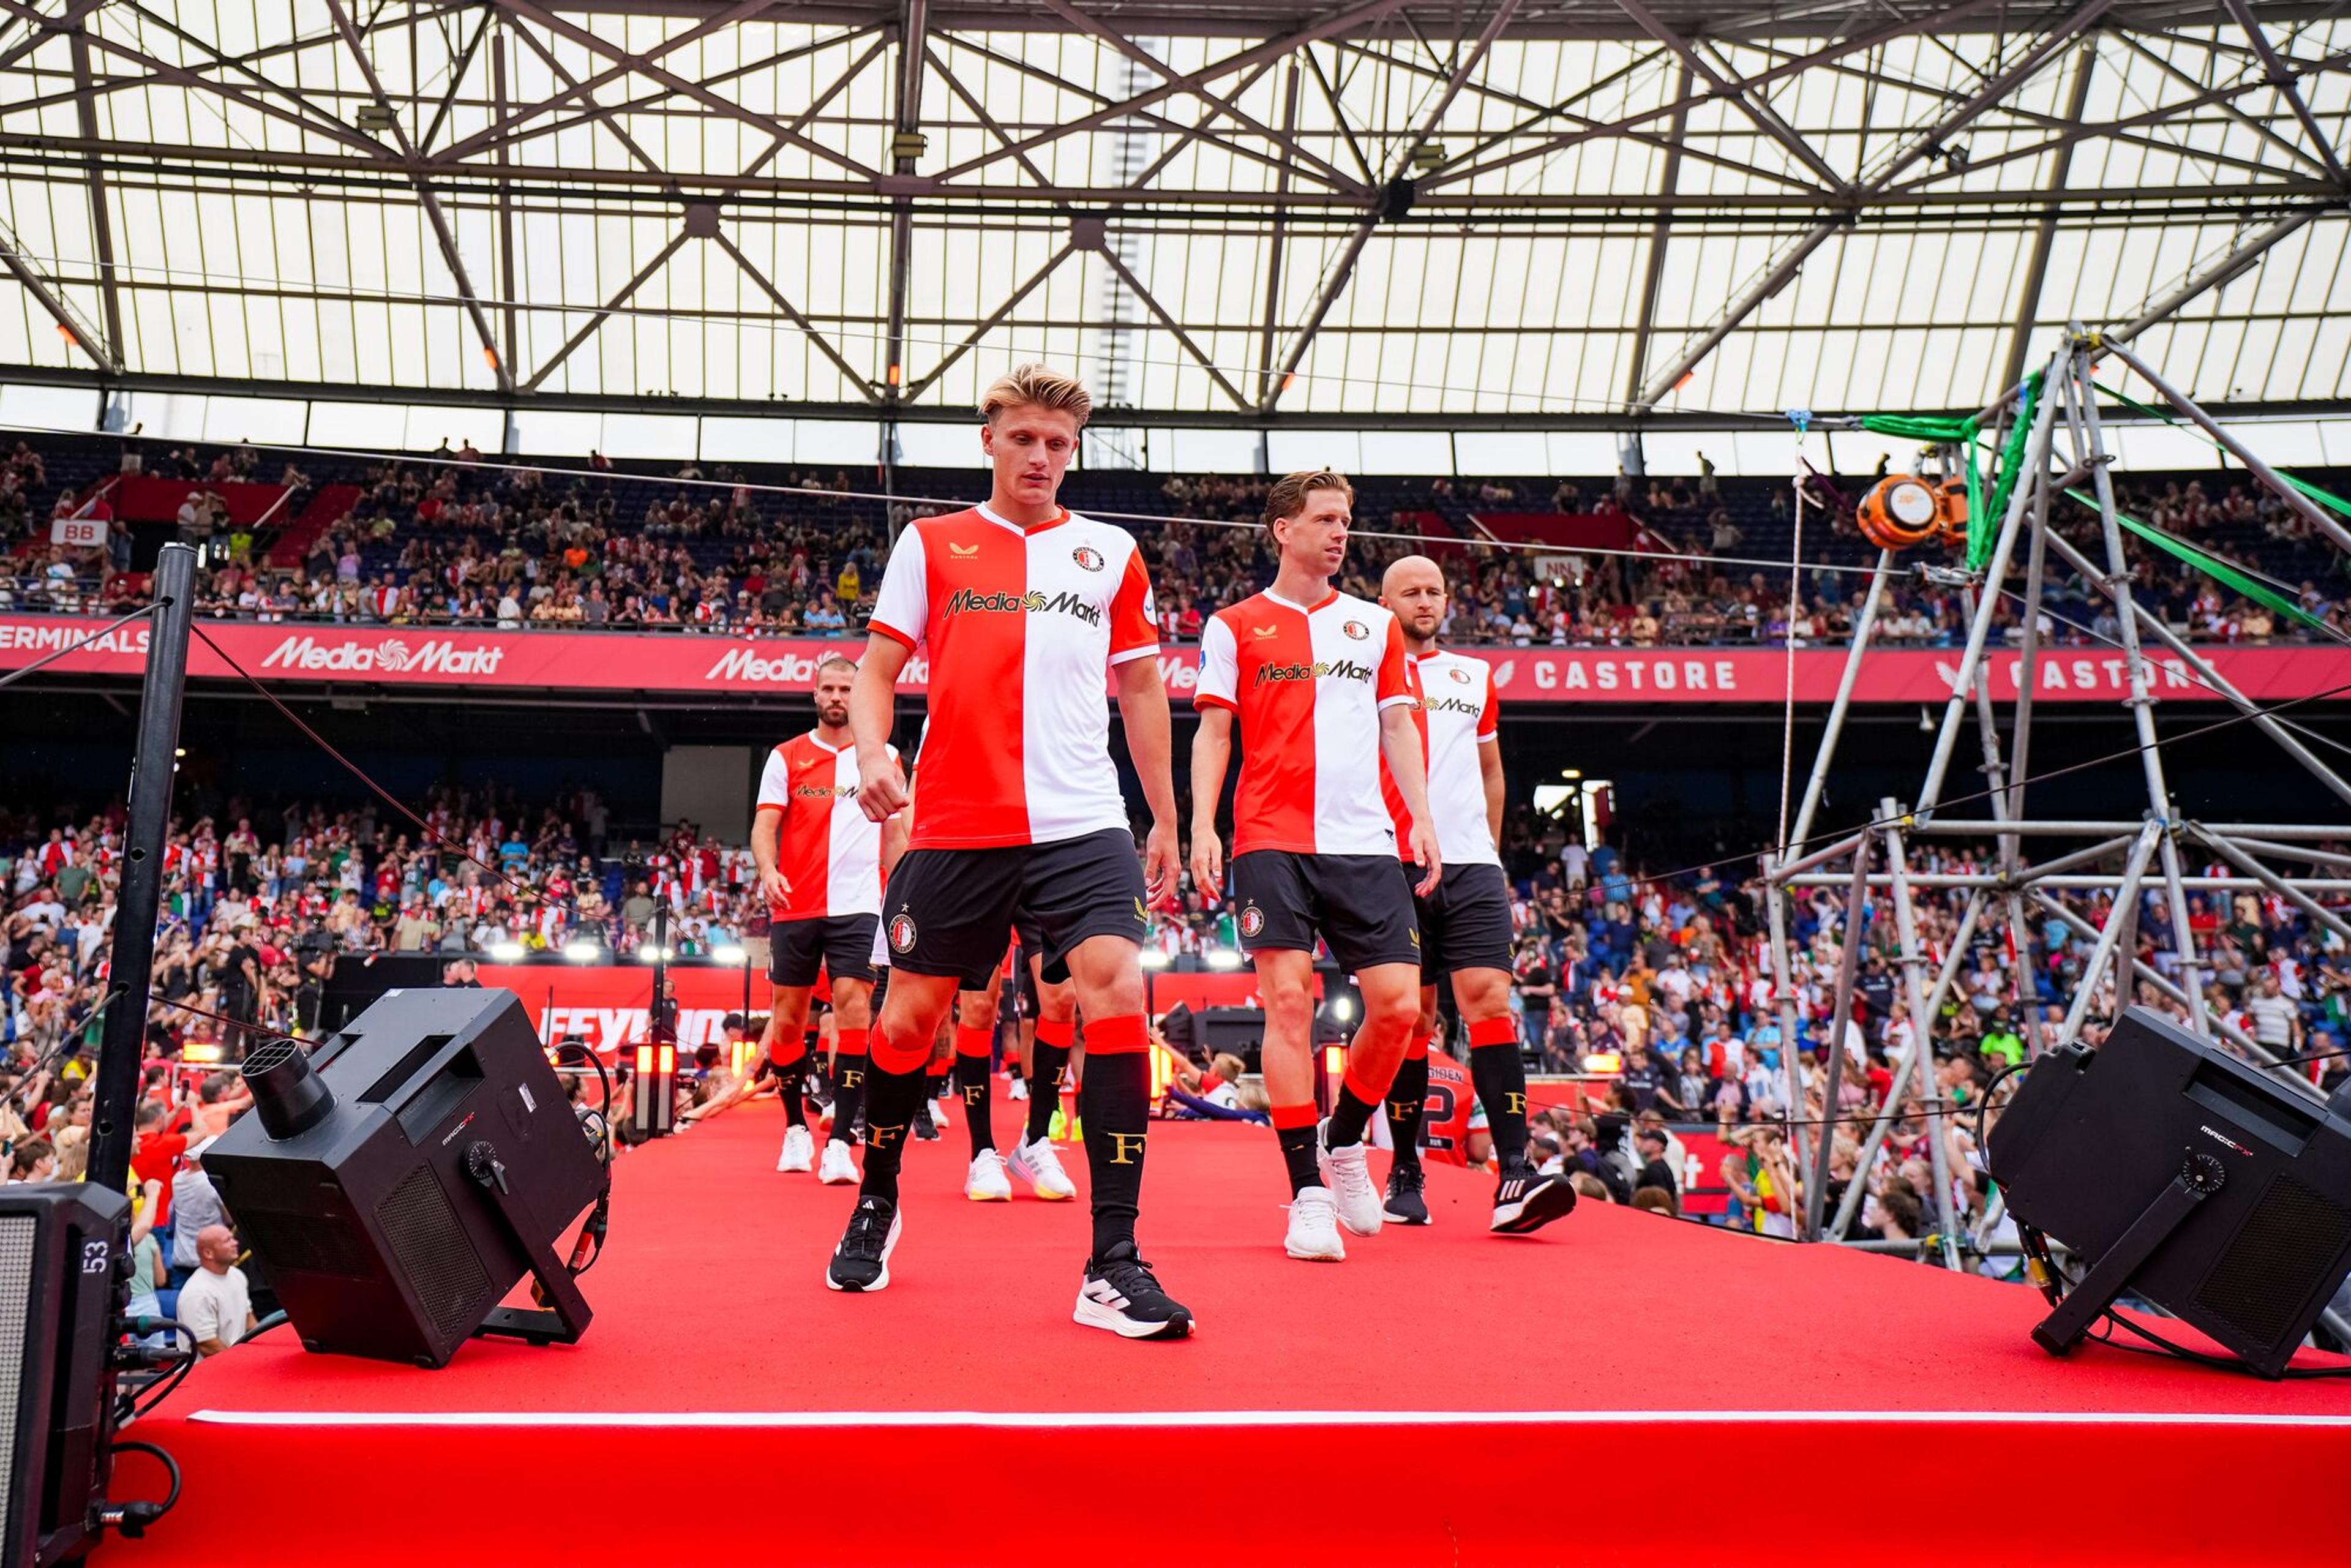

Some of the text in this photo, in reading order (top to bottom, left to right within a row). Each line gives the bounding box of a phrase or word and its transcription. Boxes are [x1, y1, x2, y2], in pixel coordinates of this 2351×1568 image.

[943, 588, 1101, 628] Media Markt
[261, 636, 503, 674] Media Markt
[705, 648, 813, 682] Media
[1254, 661, 1311, 688] Media
[1533, 660, 1737, 690] CASTORE
[841, 1070, 864, 1088] F
[963, 1084, 984, 1106] F
[1389, 1100, 1419, 1121] F
[1417, 1085, 1454, 1150] 2
[867, 1122, 905, 1149] F
[1107, 1132, 1147, 1165] F
[82, 1240, 108, 1274] 53
